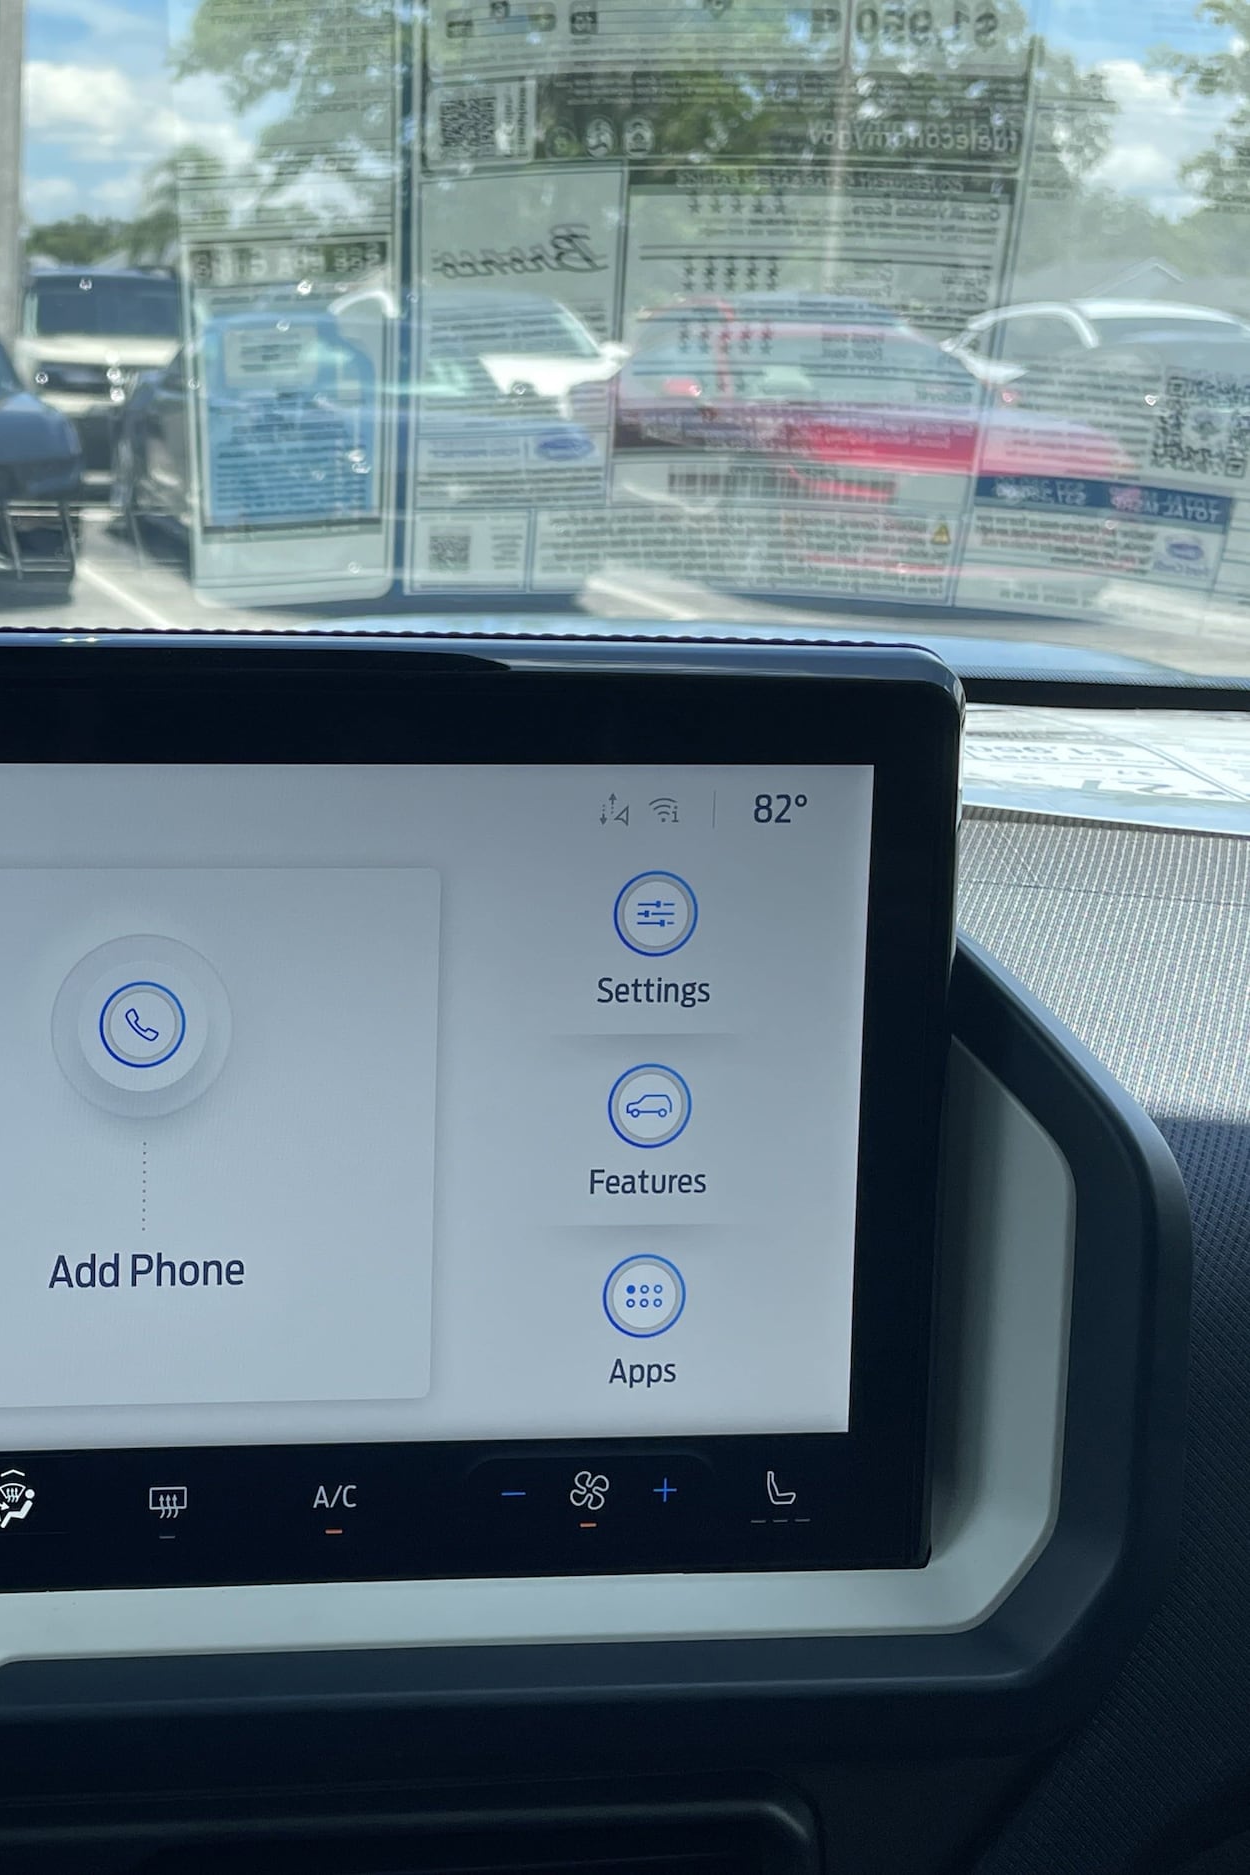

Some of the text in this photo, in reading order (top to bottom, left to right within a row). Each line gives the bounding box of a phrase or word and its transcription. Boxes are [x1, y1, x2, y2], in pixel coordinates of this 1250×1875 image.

[753, 793, 808, 824] 82°
[596, 977, 710, 1008] Settings
[589, 1168, 707, 1195] Features
[48, 1251, 245, 1289] Add Phone
[608, 1358, 677, 1389] Apps
[312, 1483, 357, 1510] A/C
